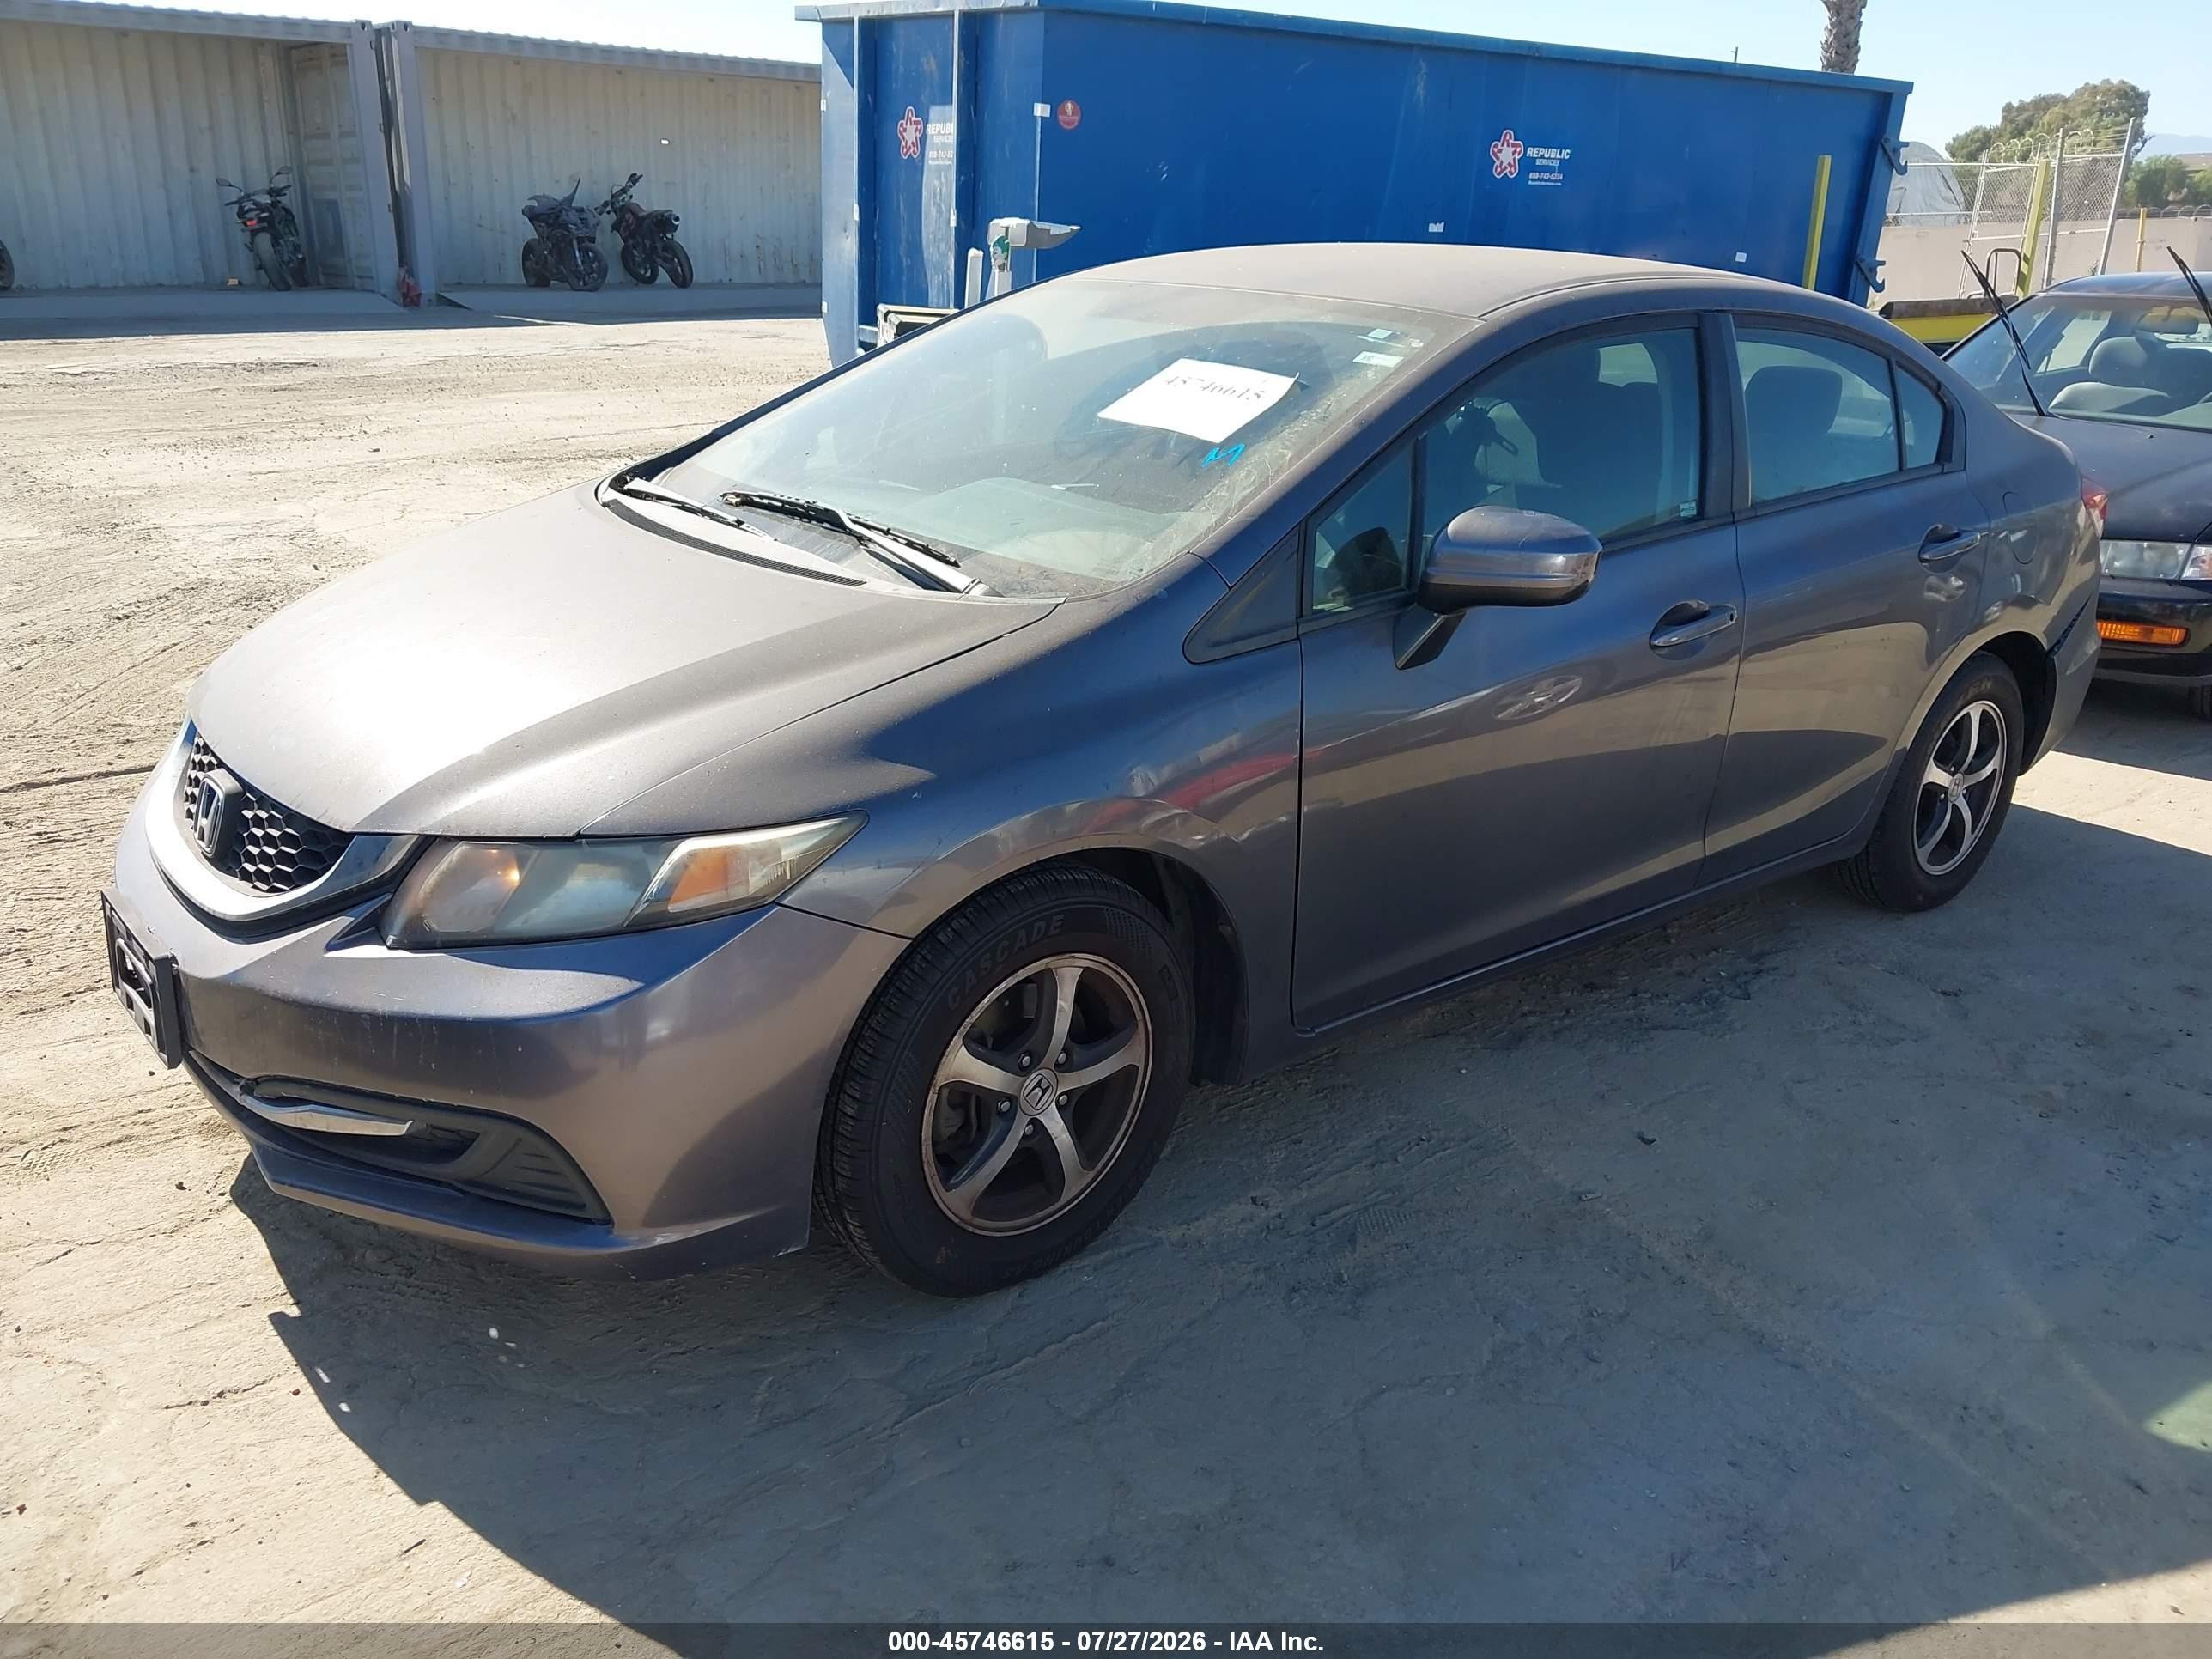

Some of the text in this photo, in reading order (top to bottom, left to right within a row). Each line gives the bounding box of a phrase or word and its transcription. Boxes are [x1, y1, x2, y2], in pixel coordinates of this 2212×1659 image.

[1526, 147, 1571, 159] REPUBLIC
[1535, 158, 1561, 167] SERVICES
[947, 913, 1065, 1010] CASCADE
